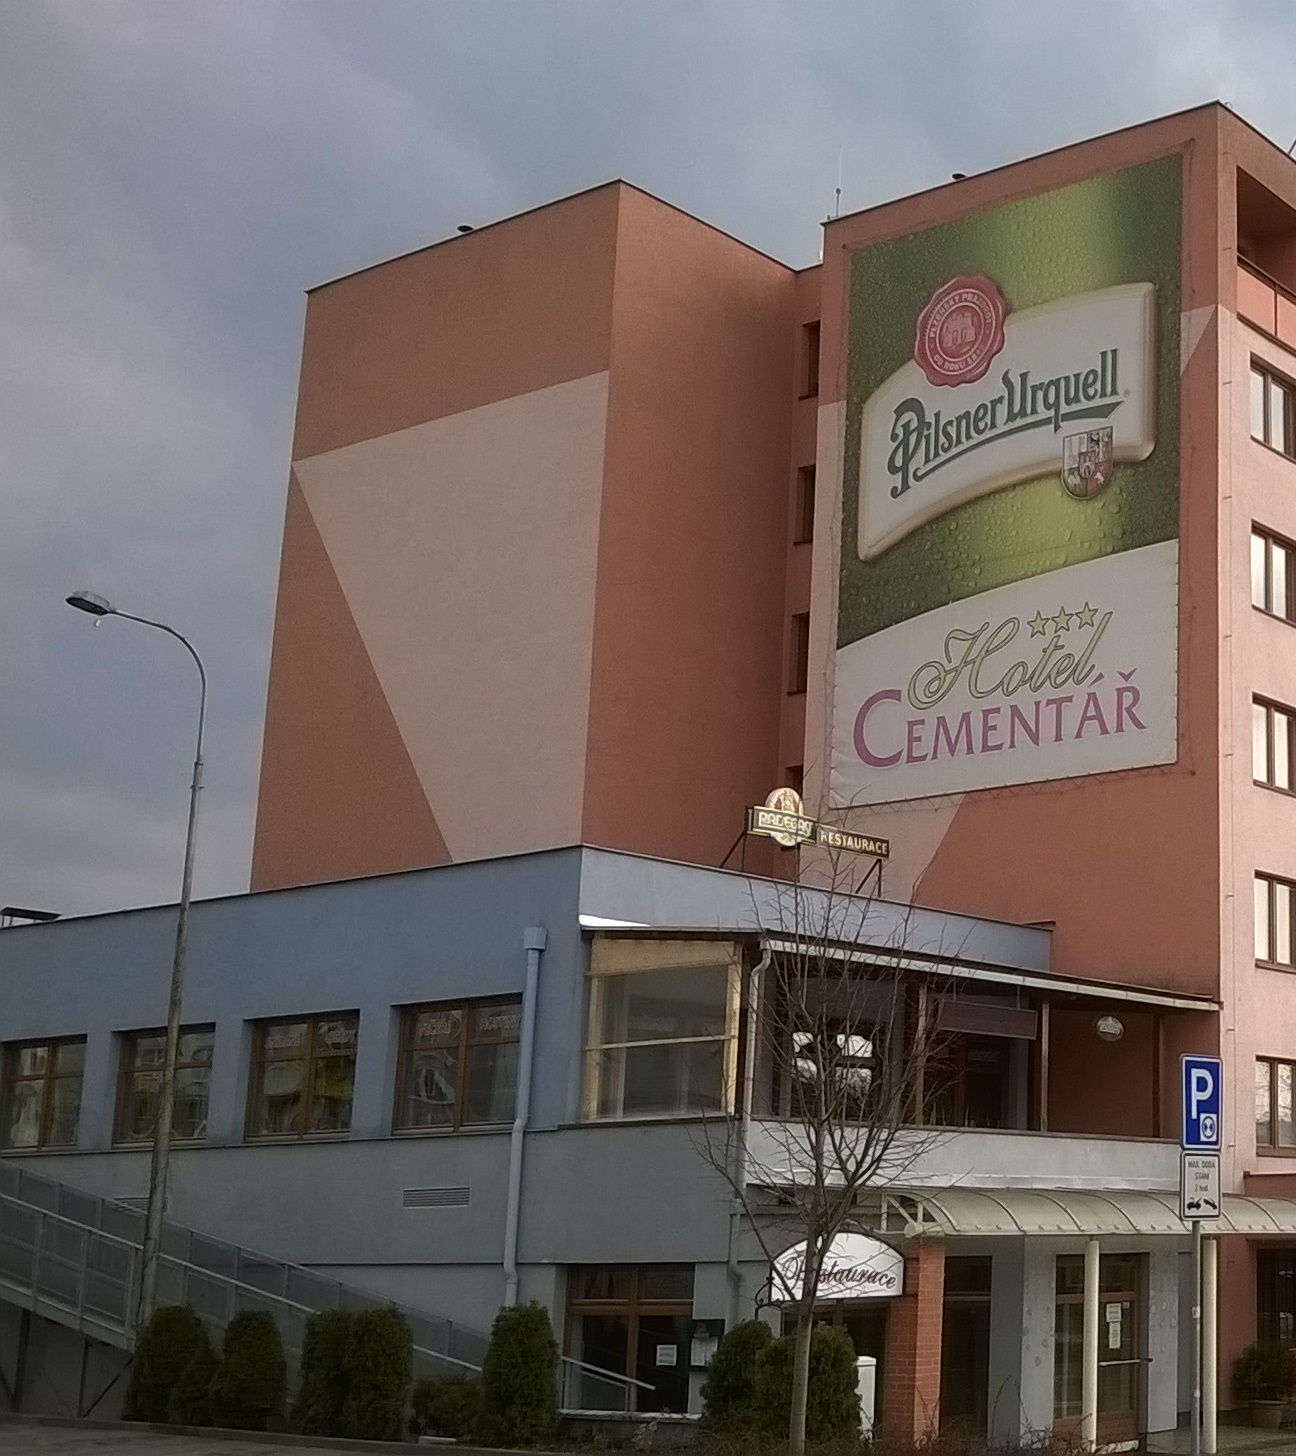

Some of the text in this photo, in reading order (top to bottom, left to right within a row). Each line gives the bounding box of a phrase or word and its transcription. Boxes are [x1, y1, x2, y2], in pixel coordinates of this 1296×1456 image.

[887, 348, 1119, 500] Pilsner Urquell
[907, 610, 1114, 710] Hotel
[852, 667, 1148, 769] CEMENTÁŘ
[819, 830, 889, 855] RESTAURACE
[1190, 1067, 1214, 1120] P
[781, 1254, 897, 1291] Rstaurace
